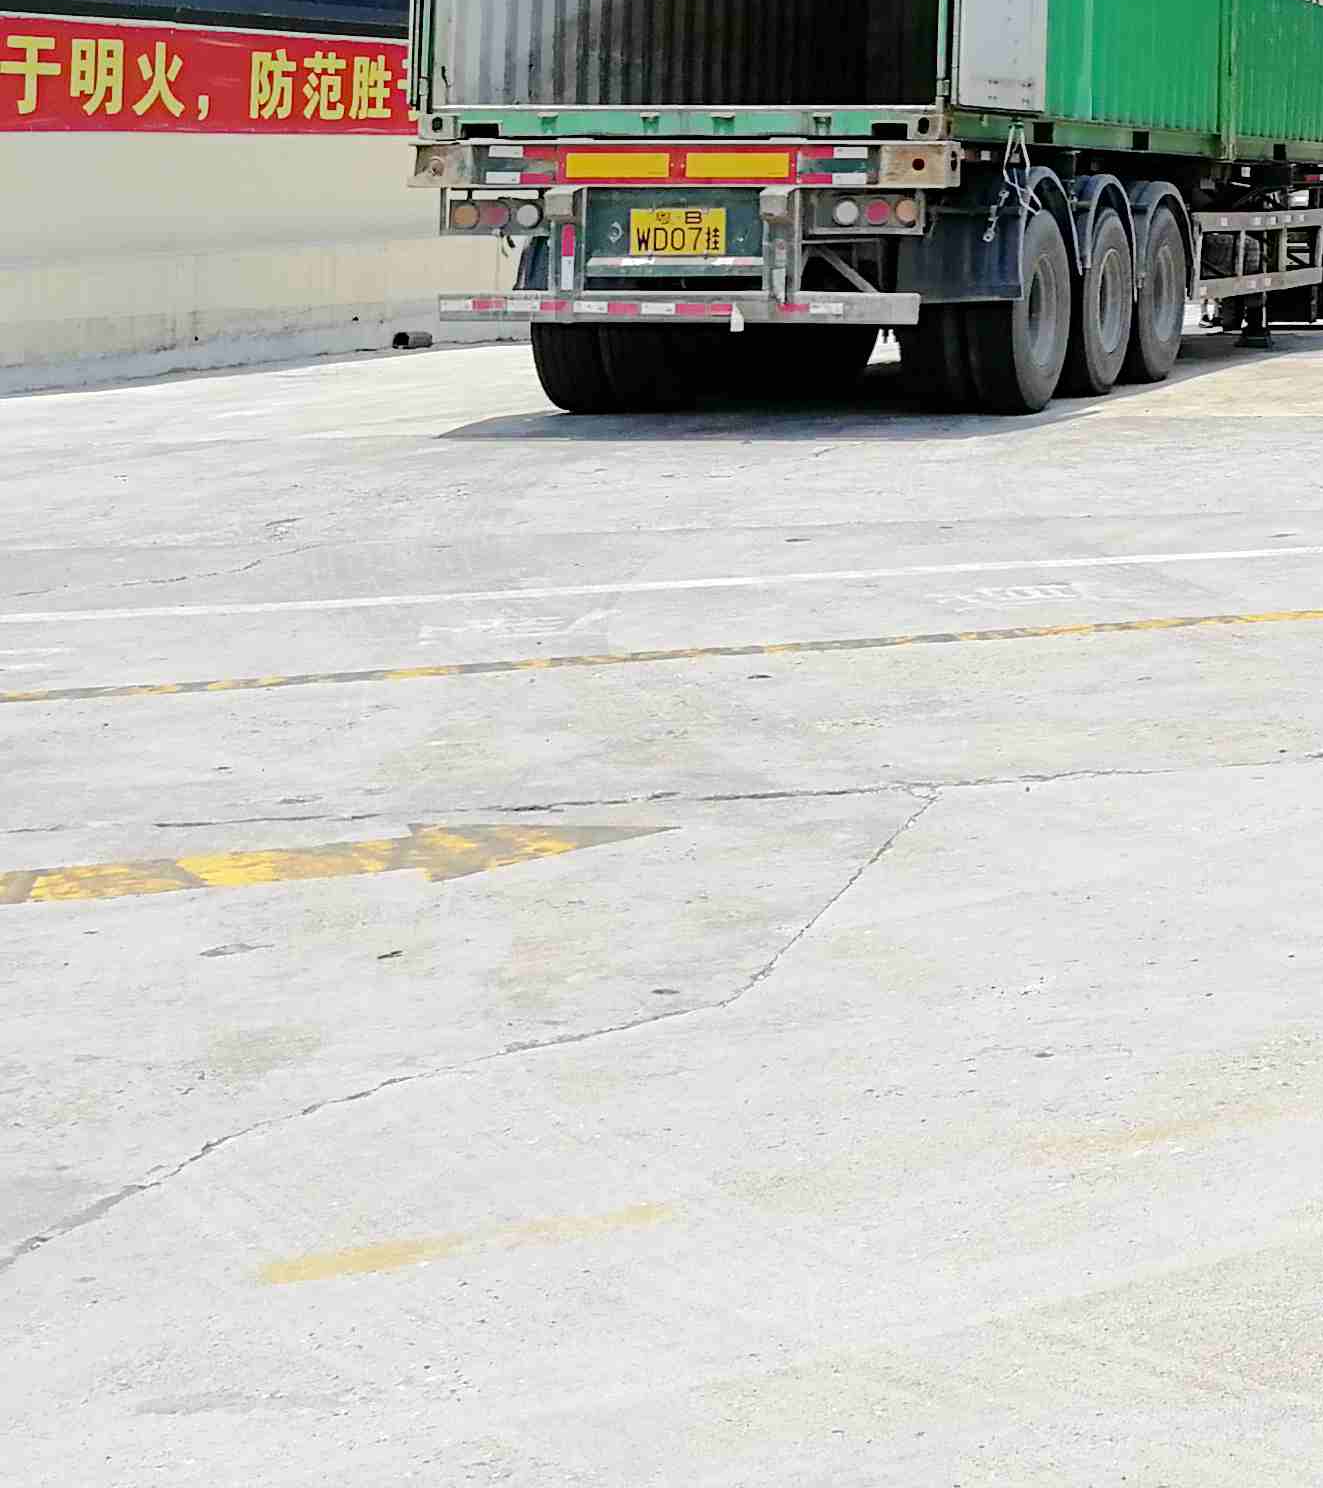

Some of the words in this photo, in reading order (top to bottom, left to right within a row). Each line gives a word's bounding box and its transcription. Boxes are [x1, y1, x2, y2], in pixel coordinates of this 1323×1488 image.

[0, 35, 418, 122] 于明火，防范胜
